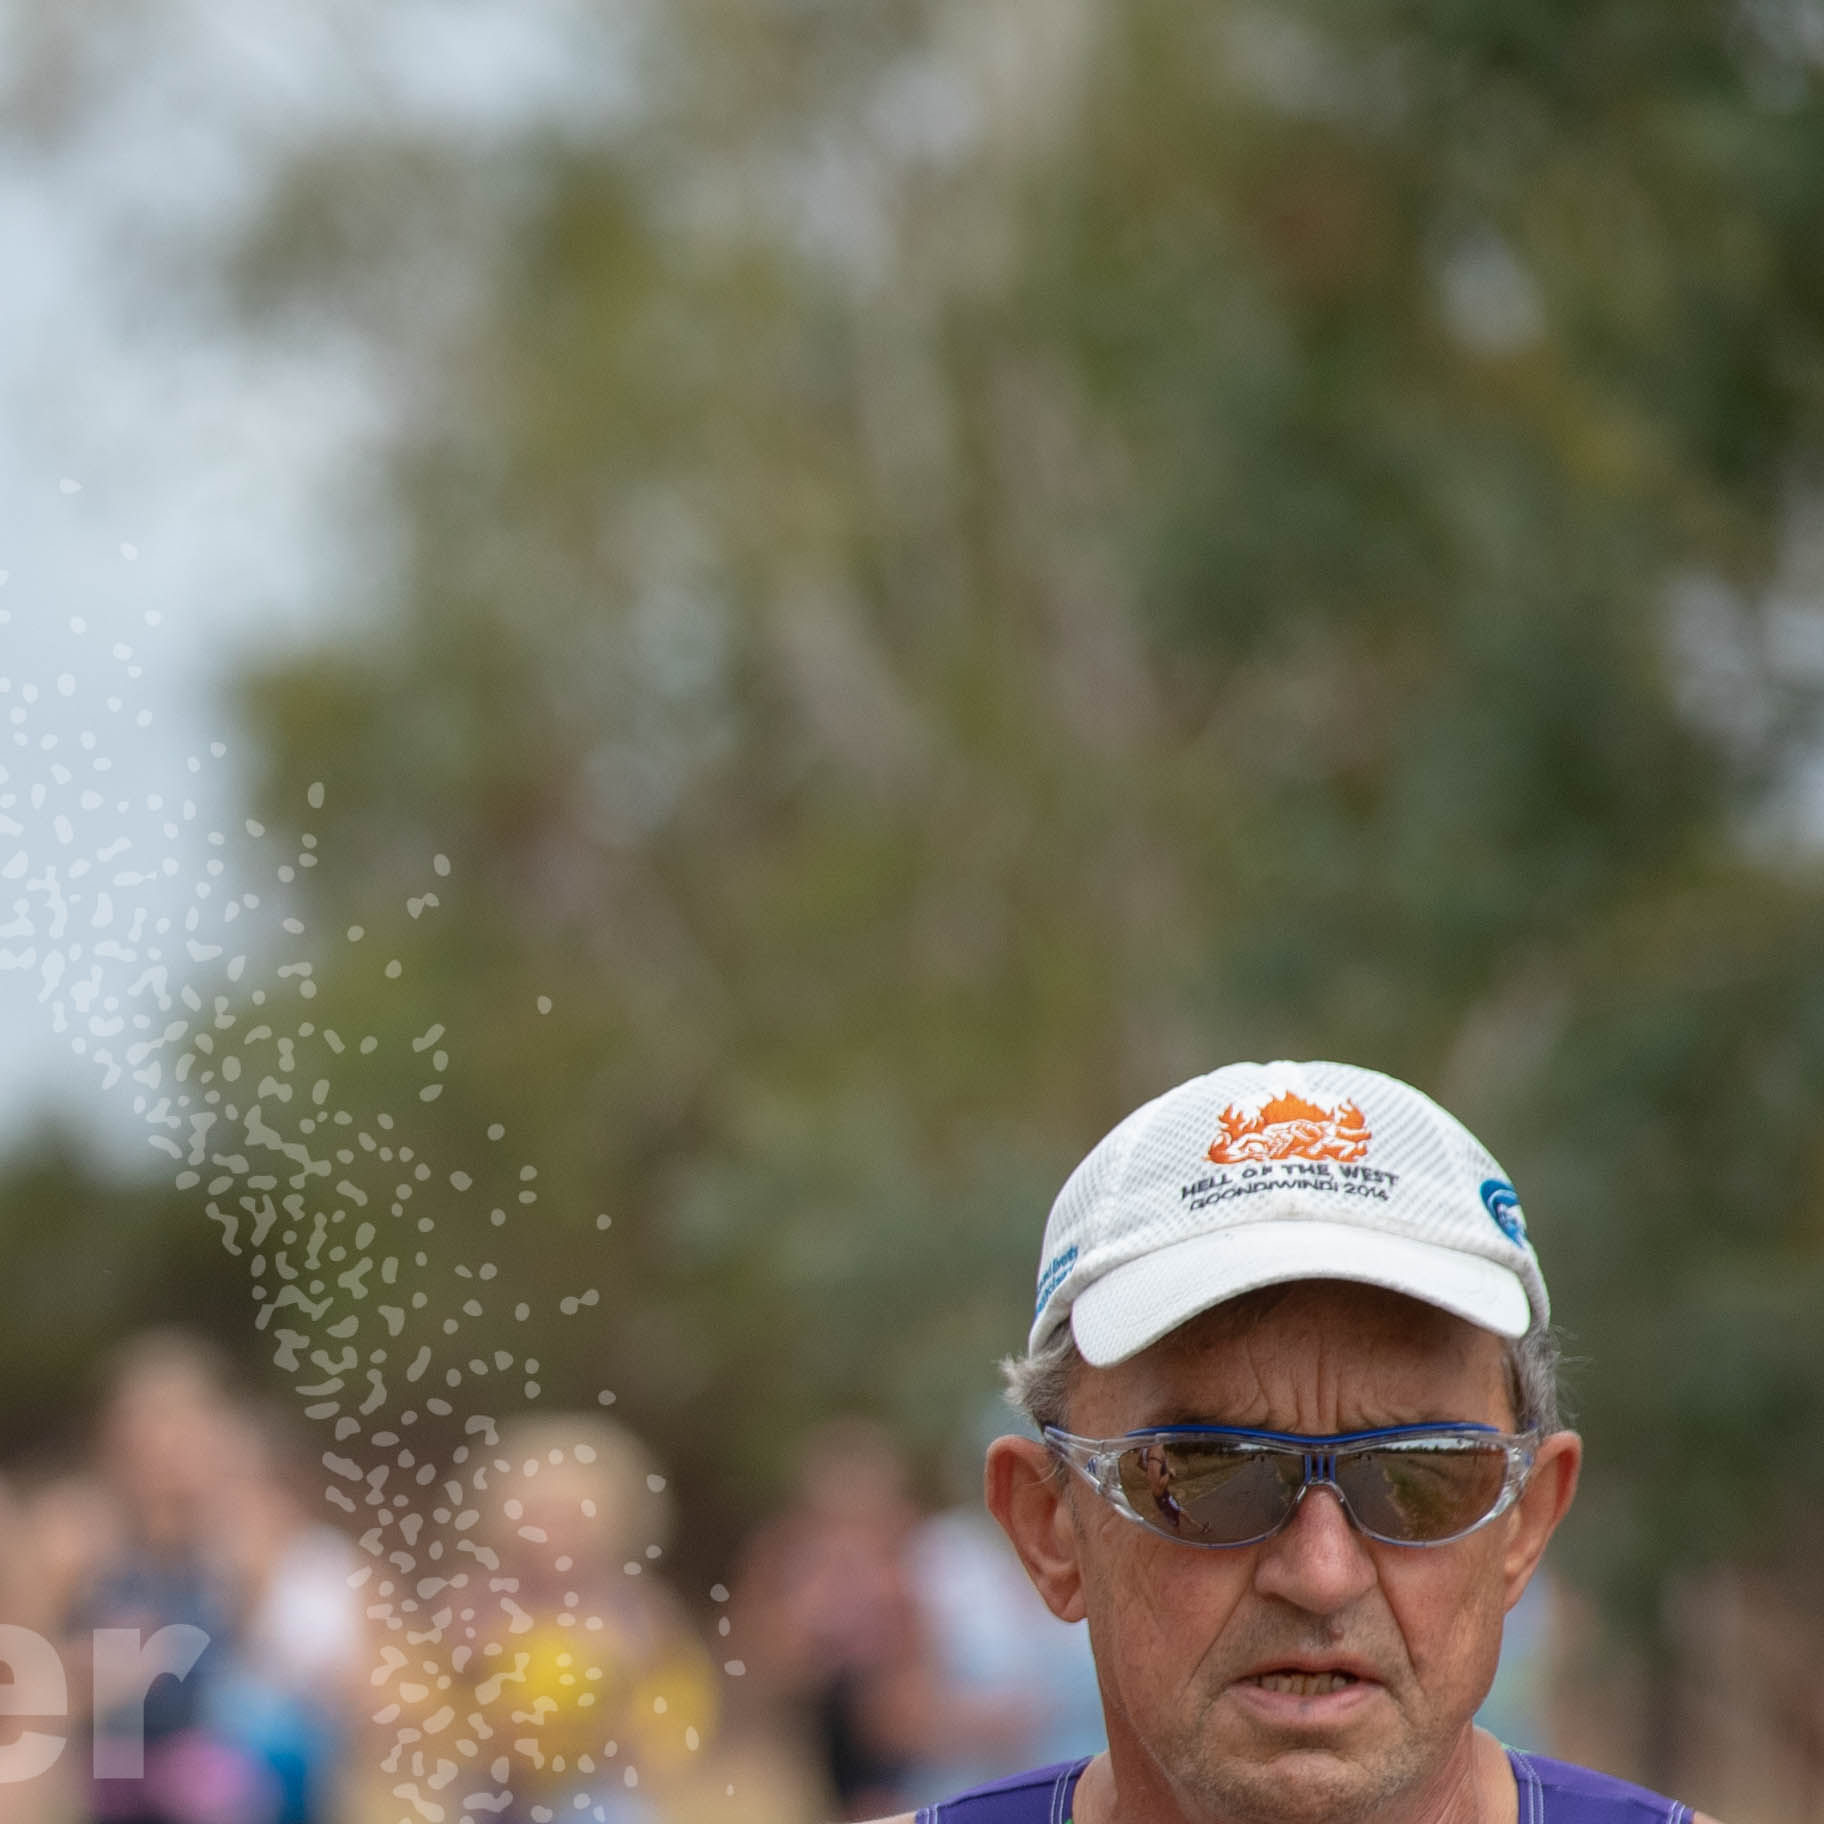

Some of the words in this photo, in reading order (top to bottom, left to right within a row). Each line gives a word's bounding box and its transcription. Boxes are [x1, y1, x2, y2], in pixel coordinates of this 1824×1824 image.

[1181, 1173, 1233, 1200] HELL
[1242, 1166, 1272, 1179] OF
[1281, 1164, 1329, 1177] THE
[1339, 1165, 1400, 1186] WEST
[1344, 1183, 1389, 1201] 2014
